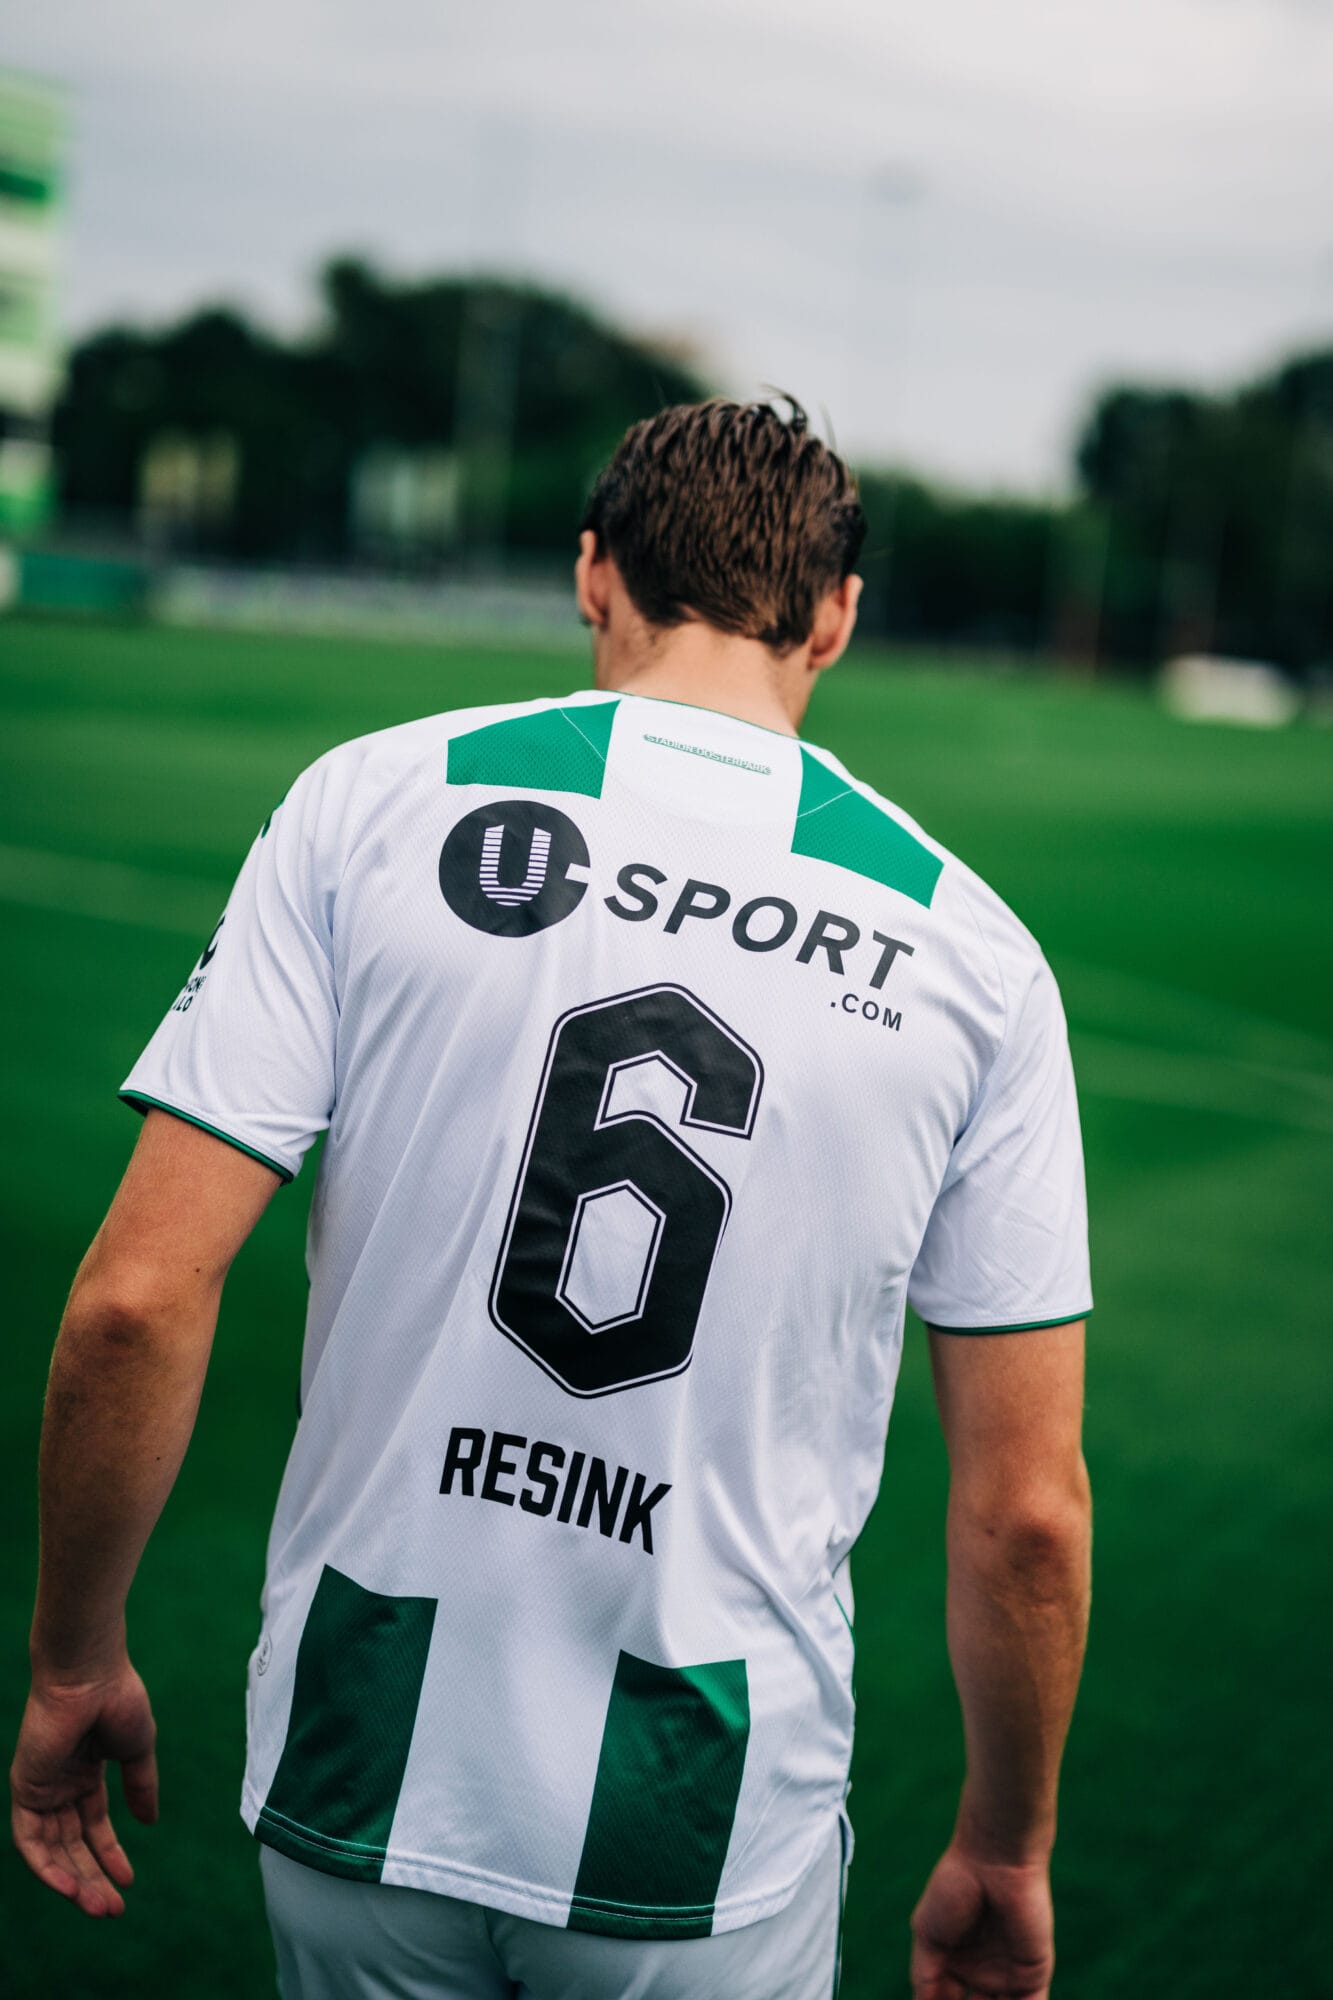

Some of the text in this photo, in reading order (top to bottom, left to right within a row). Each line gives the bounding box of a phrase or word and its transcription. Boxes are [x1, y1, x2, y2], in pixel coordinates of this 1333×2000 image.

[603, 863, 915, 990] SPORT
[830, 993, 902, 1032] .COM
[488, 982, 765, 1400] 6
[439, 1427, 673, 1556] RESINK
